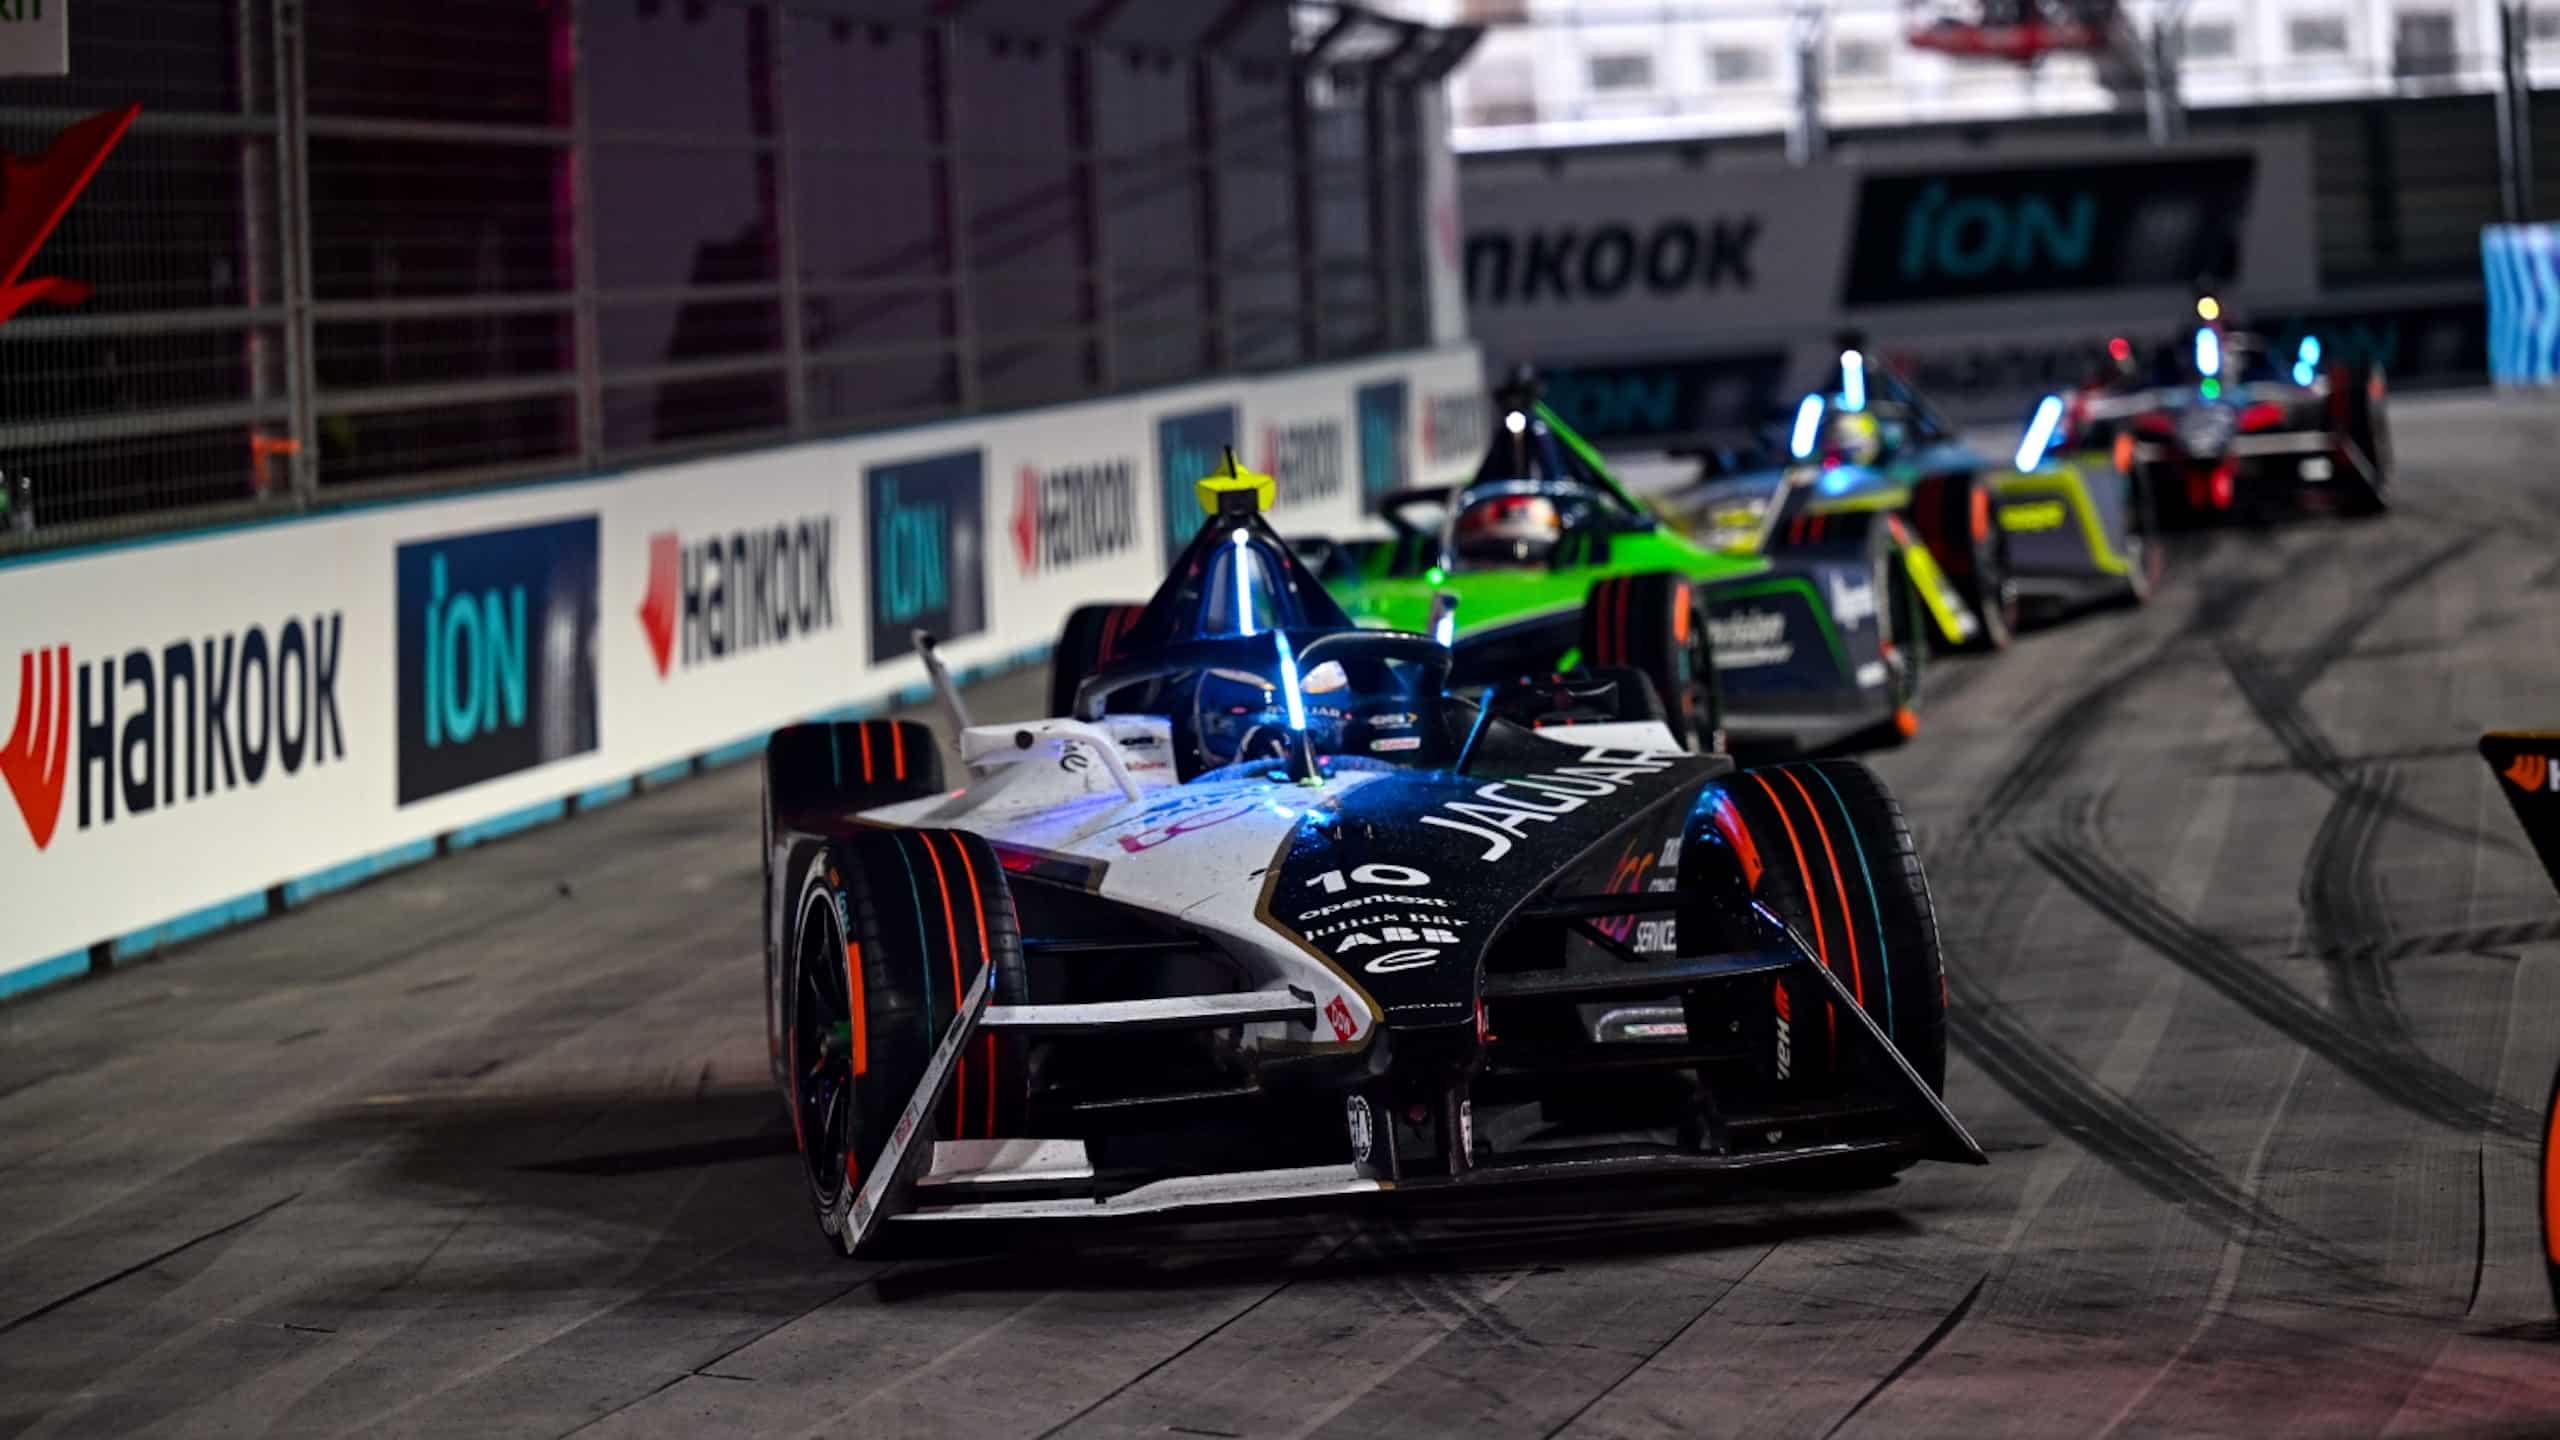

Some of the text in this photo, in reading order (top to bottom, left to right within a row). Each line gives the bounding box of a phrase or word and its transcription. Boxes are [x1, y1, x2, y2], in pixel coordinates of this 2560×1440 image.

[1464, 214, 1764, 303] nKOOK
[1305, 863, 1431, 894] 10
[1335, 926, 1461, 954] ABB
